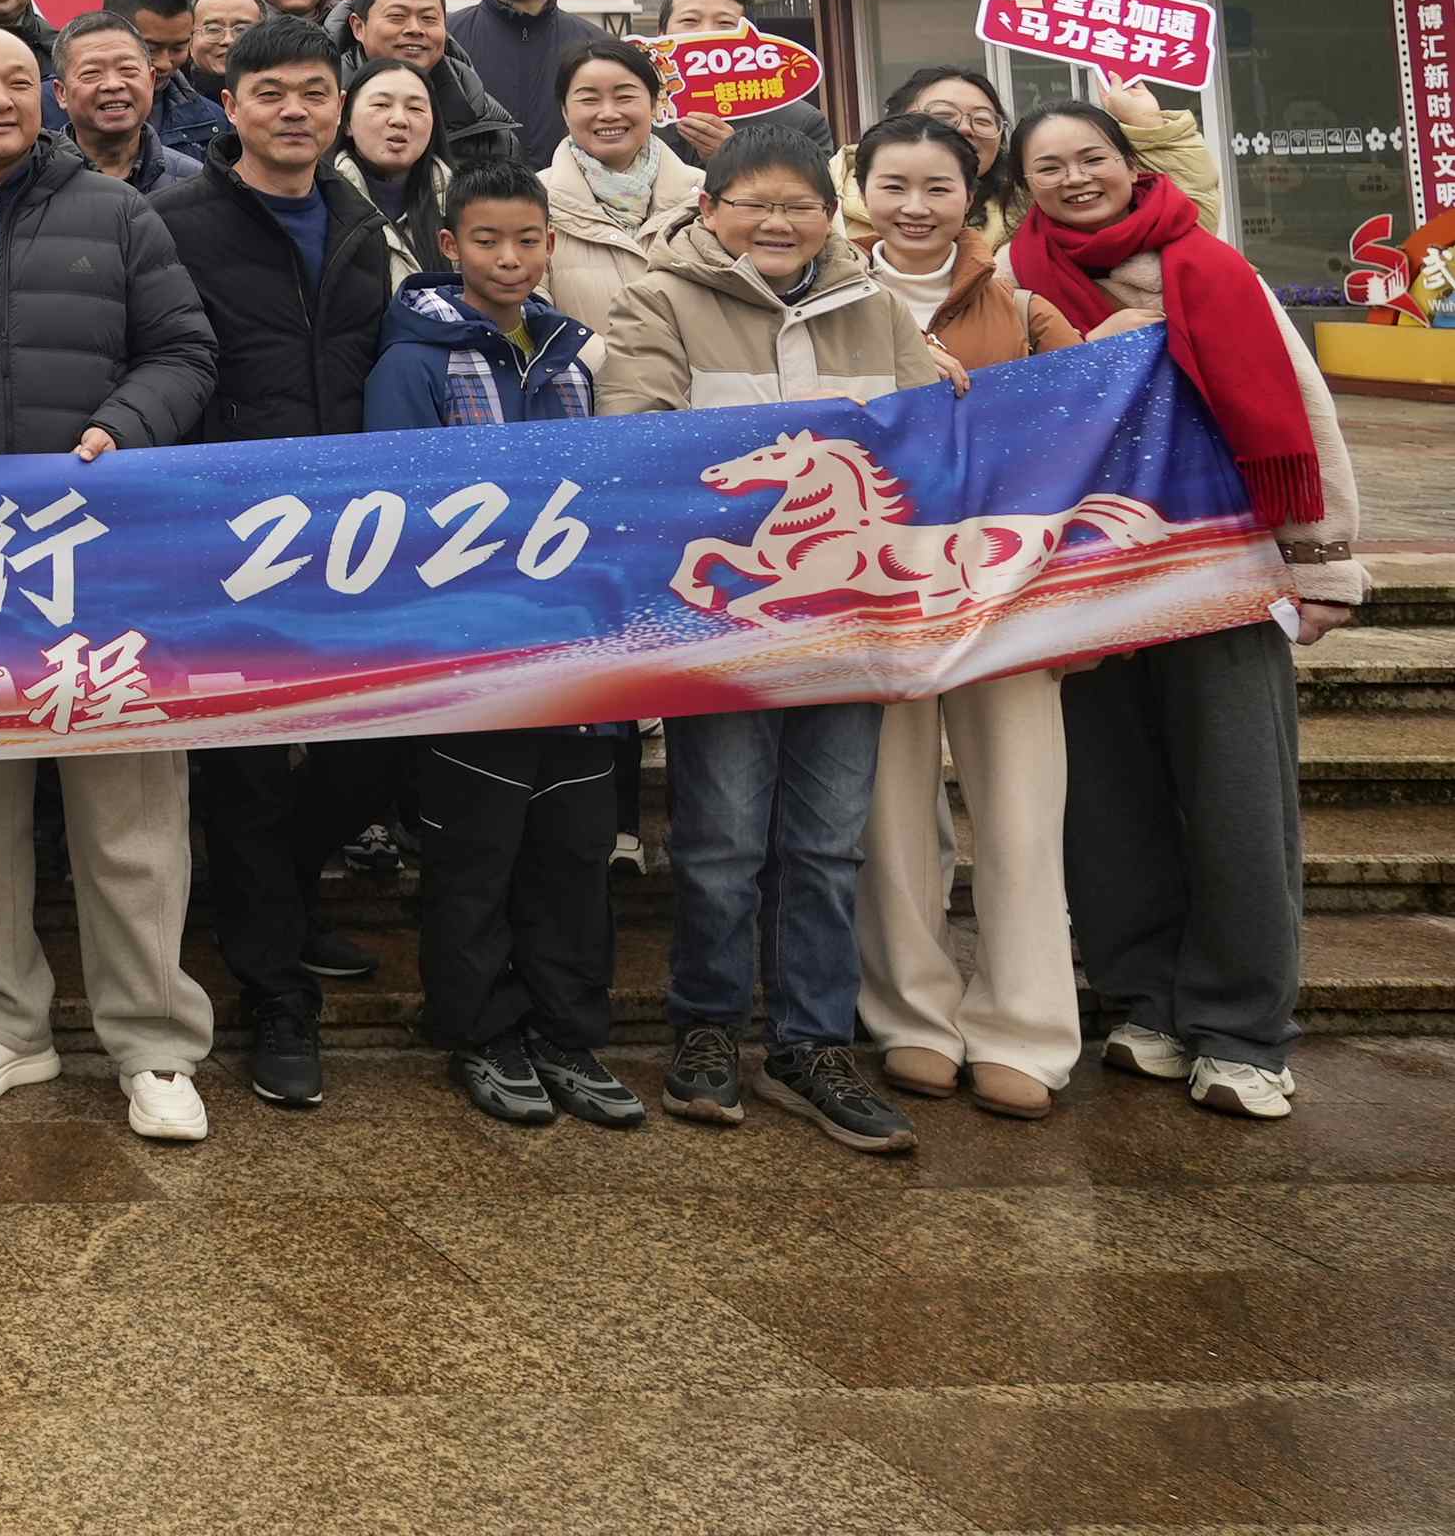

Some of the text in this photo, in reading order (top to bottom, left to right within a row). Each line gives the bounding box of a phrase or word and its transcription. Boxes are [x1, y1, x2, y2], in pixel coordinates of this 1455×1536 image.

[684, 44, 781, 76] 2026
[1017, 9, 1167, 68] 马力全开
[691, 77, 785, 103] 一起拼搏
[220, 478, 591, 604] 2026
